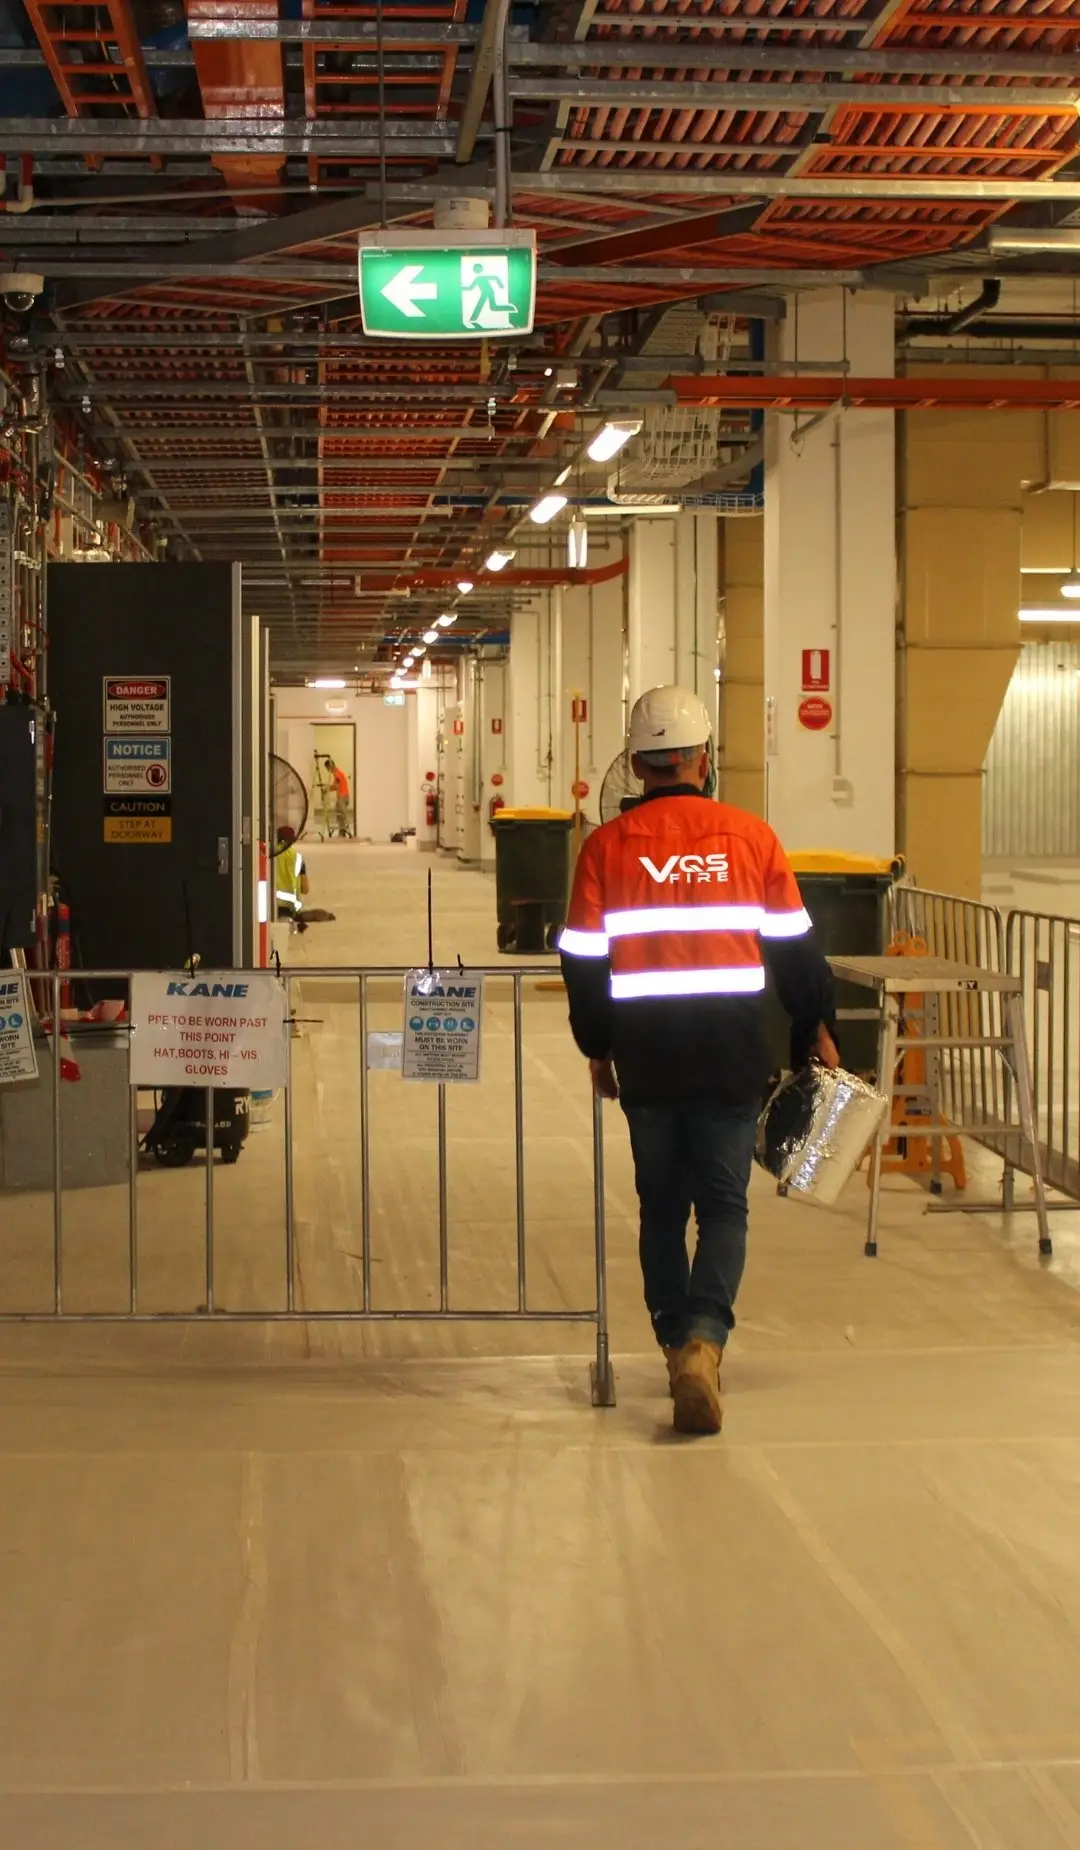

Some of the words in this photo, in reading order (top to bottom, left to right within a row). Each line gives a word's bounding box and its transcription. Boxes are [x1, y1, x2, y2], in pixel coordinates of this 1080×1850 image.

[116, 686, 157, 696] DANGER
[113, 745, 161, 755] NOTICE
[110, 802, 165, 812] CAUTION
[119, 821, 142, 829] STEP
[143, 821, 156, 829] AT
[111, 831, 164, 839] DOORWAY
[638, 853, 729, 883] VQS
[669, 872, 729, 884] FIRE
[166, 982, 249, 997] KANE
[411, 985, 476, 998] KANE
[148, 1015, 169, 1025] PPE
[172, 1016, 186, 1025] TO
[188, 1016, 202, 1026] BE
[204, 1017, 238, 1027] WORN
[240, 1018, 267, 1027] PAST
[180, 1032, 202, 1041] THIS
[204, 1033, 236, 1042] POINT
[185, 1065, 228, 1075] GLOVES
